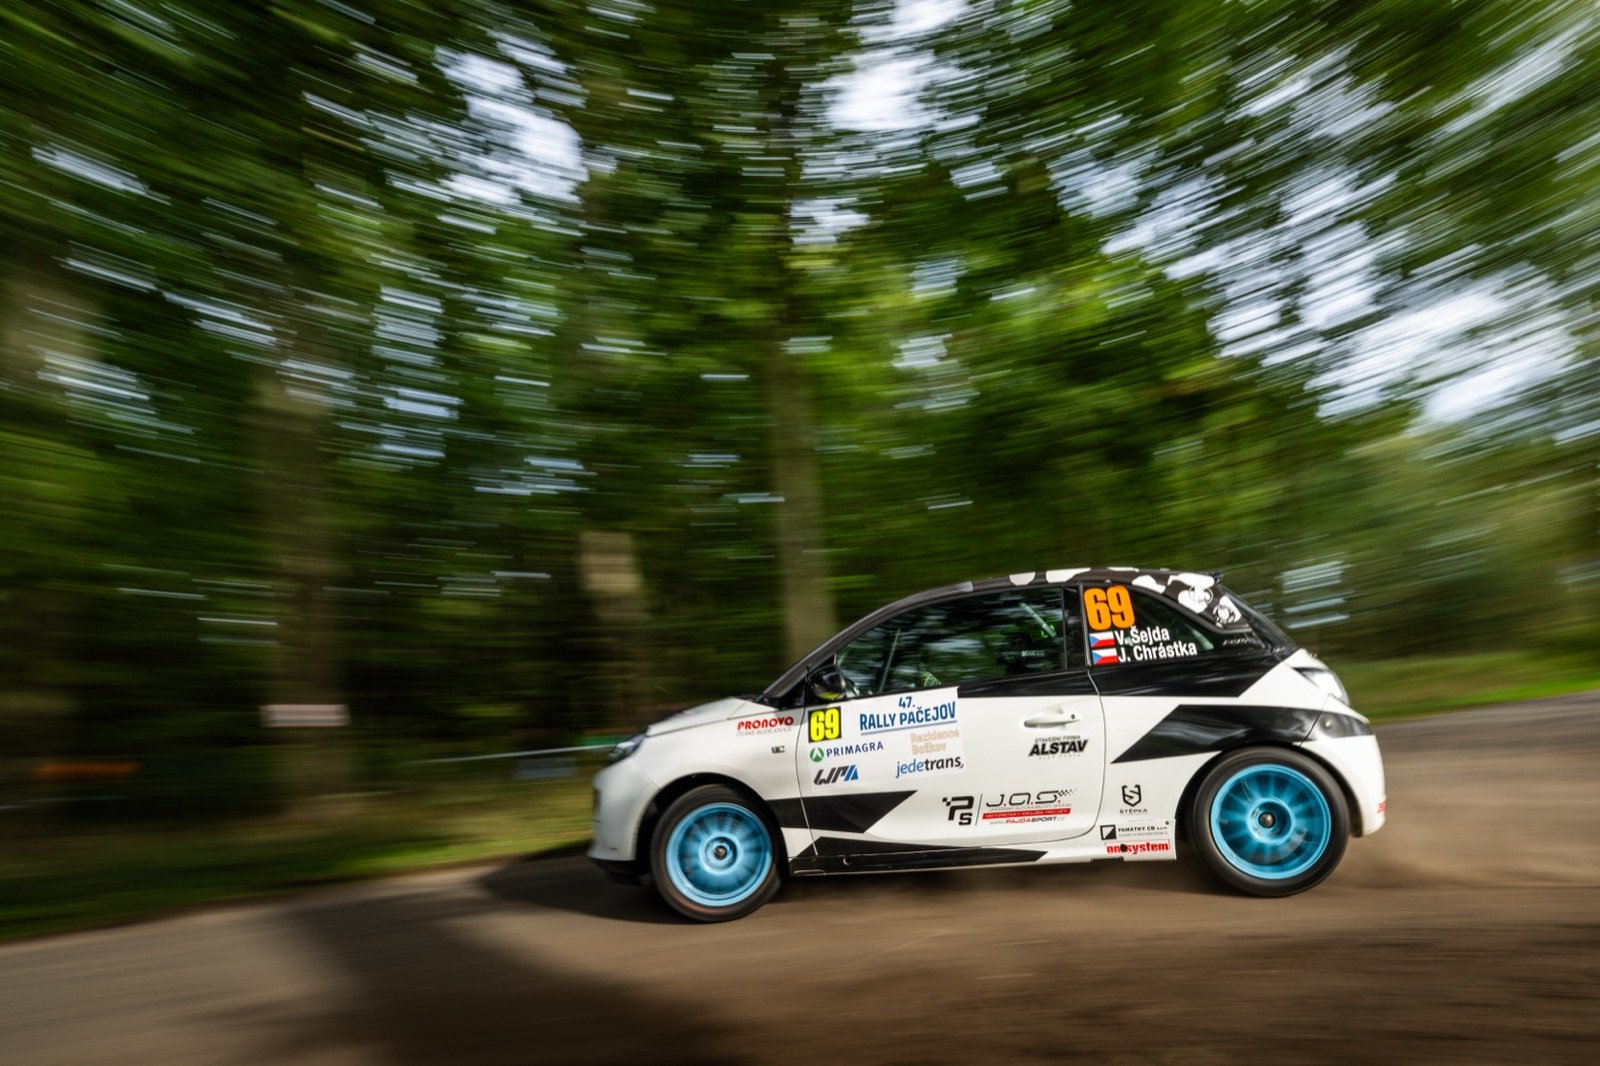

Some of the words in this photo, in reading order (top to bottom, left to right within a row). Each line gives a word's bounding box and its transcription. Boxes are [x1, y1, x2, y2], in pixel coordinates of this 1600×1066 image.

[1083, 585, 1135, 631] 69
[1114, 630, 1129, 646] V.
[1130, 625, 1170, 647] Šejda
[1117, 648, 1132, 663] J.
[1133, 642, 1198, 661] Chrástka
[898, 696, 915, 709] 47.
[737, 716, 794, 730] PRONOVO
[809, 708, 840, 742] 69
[859, 713, 896, 731] RALLY
[899, 701, 956, 726] PAČEJOV
[826, 741, 884, 757] PRIMAGRA
[1028, 739, 1089, 756] ALSTAV
